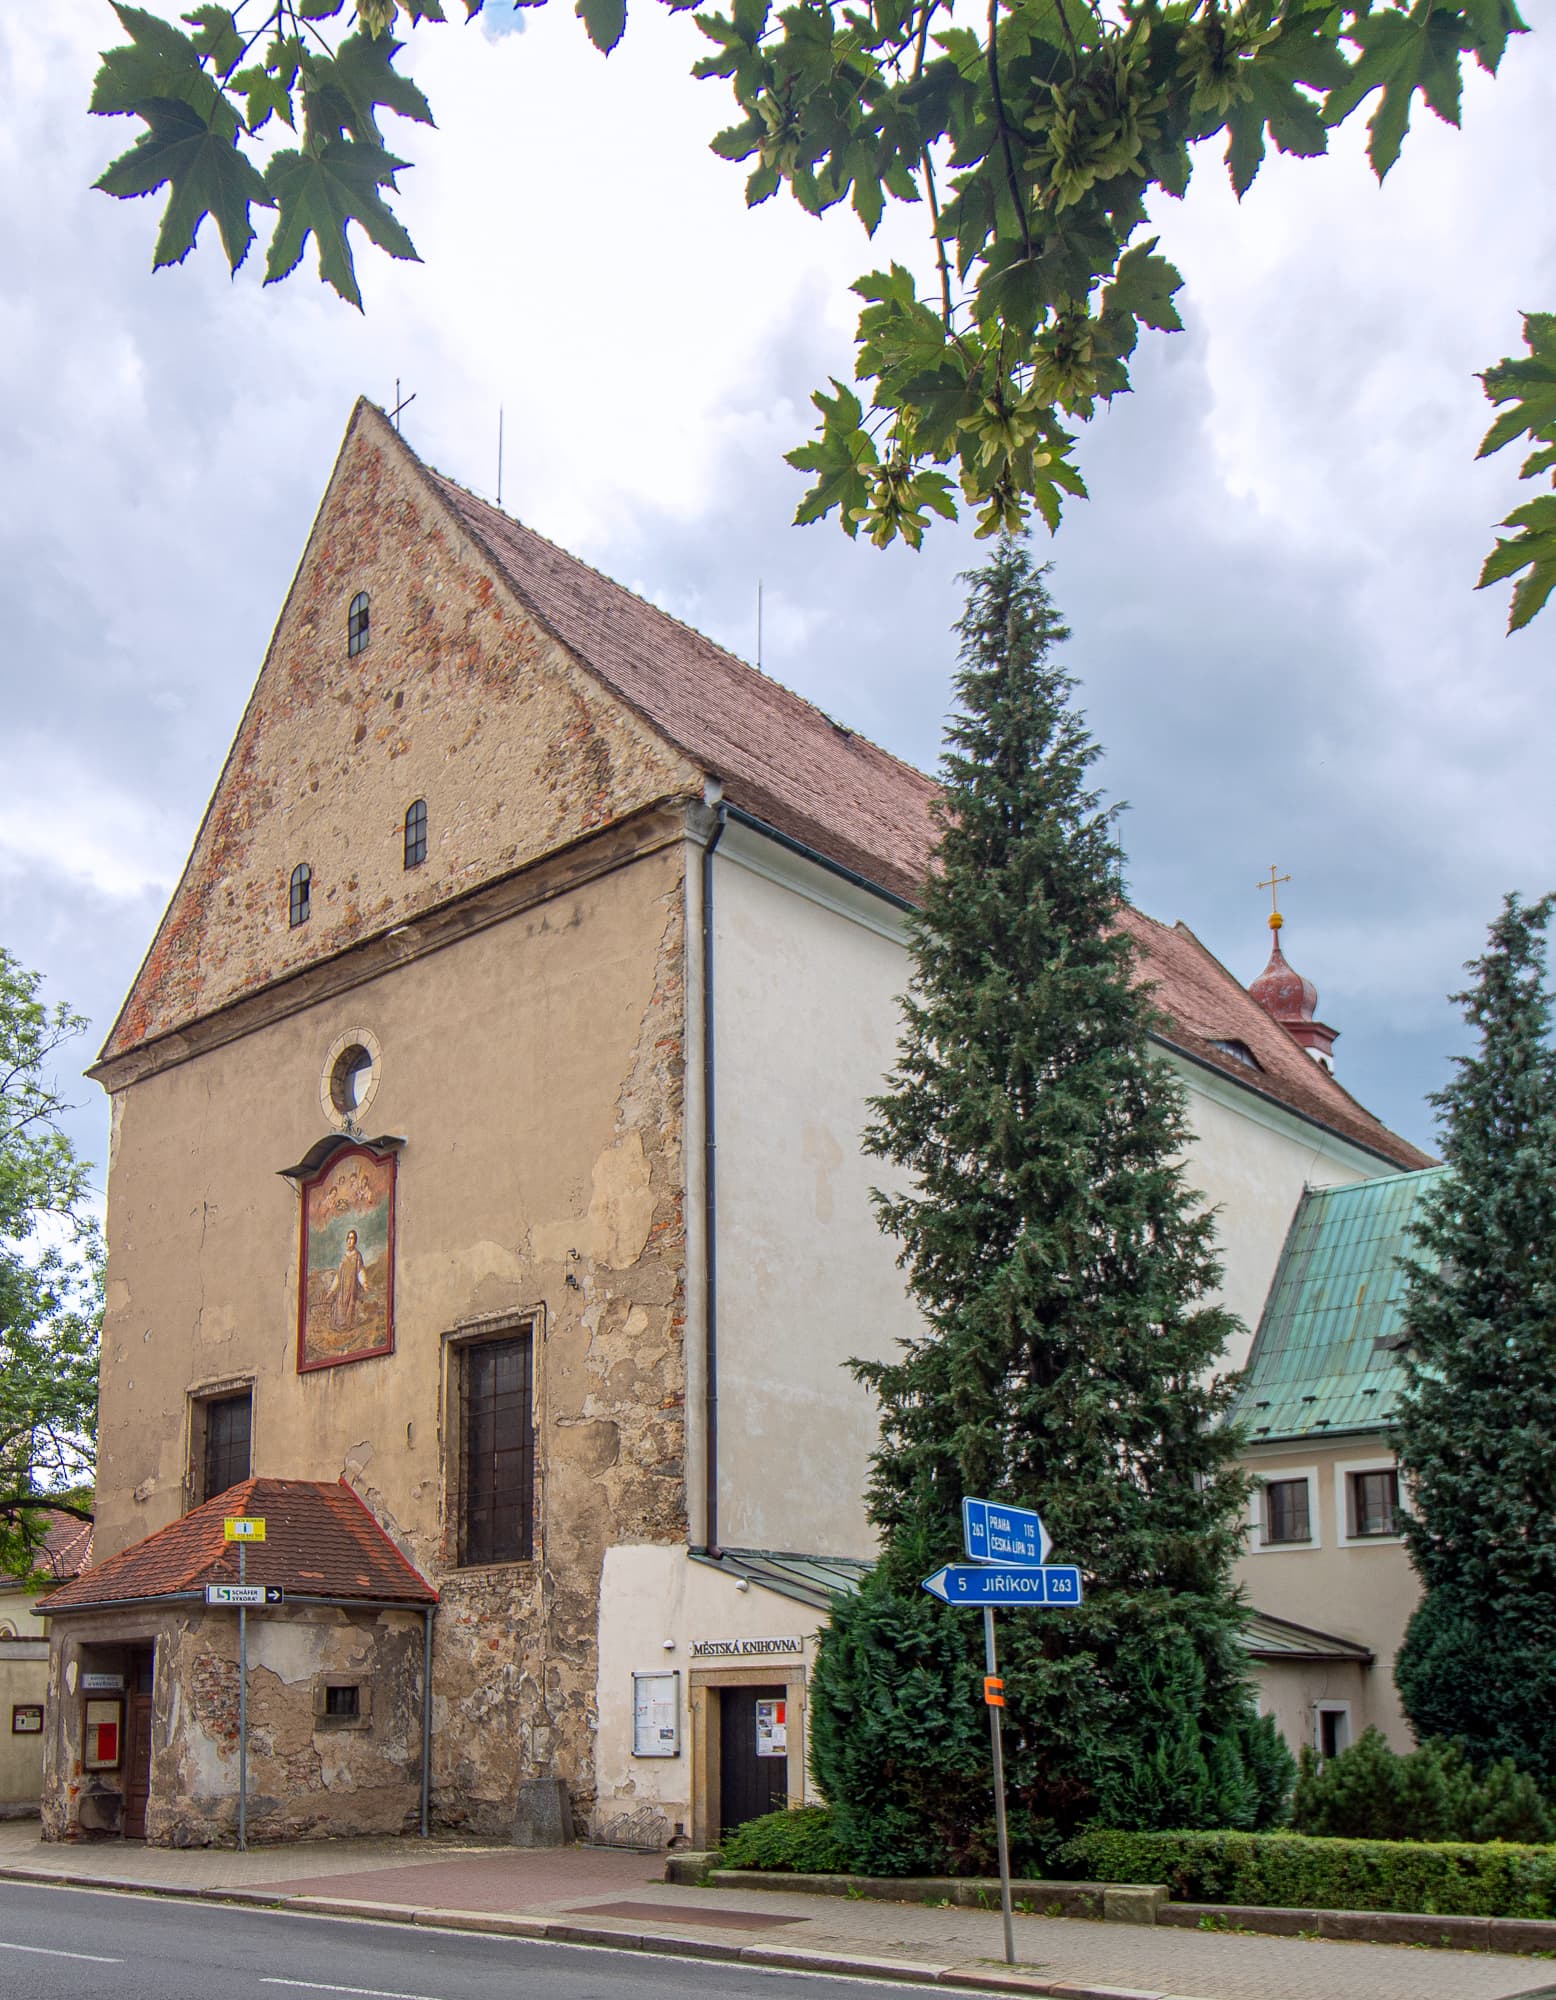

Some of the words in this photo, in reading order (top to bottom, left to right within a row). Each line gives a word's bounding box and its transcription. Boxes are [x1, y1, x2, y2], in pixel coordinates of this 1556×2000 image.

[972, 1522, 984, 1537] 263
[989, 1515, 1011, 1532] PRAHA
[1023, 1523, 1035, 1538] 115
[991, 1533, 1012, 1552] ČESKÁ
[1012, 1537, 1026, 1555] LÍPA
[958, 1577, 967, 1592] 5
[982, 1574, 1039, 1592] JIŘÍKOV
[1052, 1578, 1072, 1592] 263
[694, 1639, 740, 1655] MĚSTSKÁ
[742, 1639, 797, 1654] KNIHOVNA
